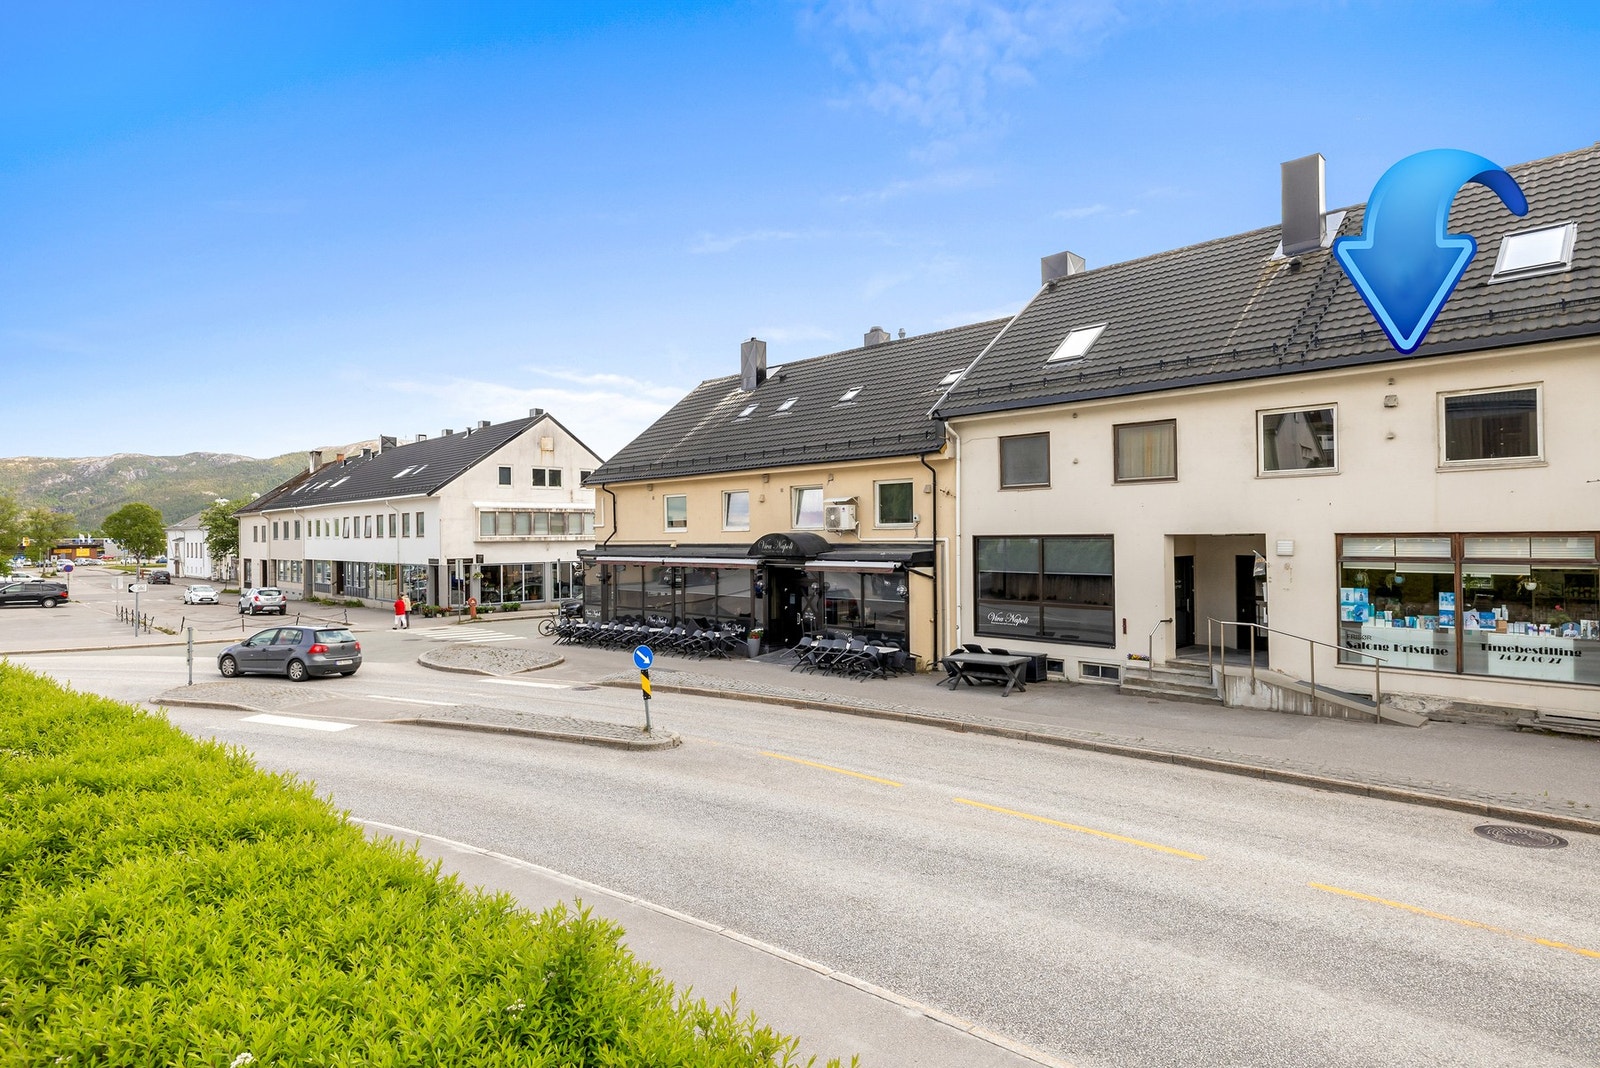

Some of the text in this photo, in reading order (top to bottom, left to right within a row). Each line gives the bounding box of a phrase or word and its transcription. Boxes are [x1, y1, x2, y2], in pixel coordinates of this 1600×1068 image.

[1345, 641, 1449, 656] Salong Kristine
[1481, 643, 1582, 657] Timebestilling
